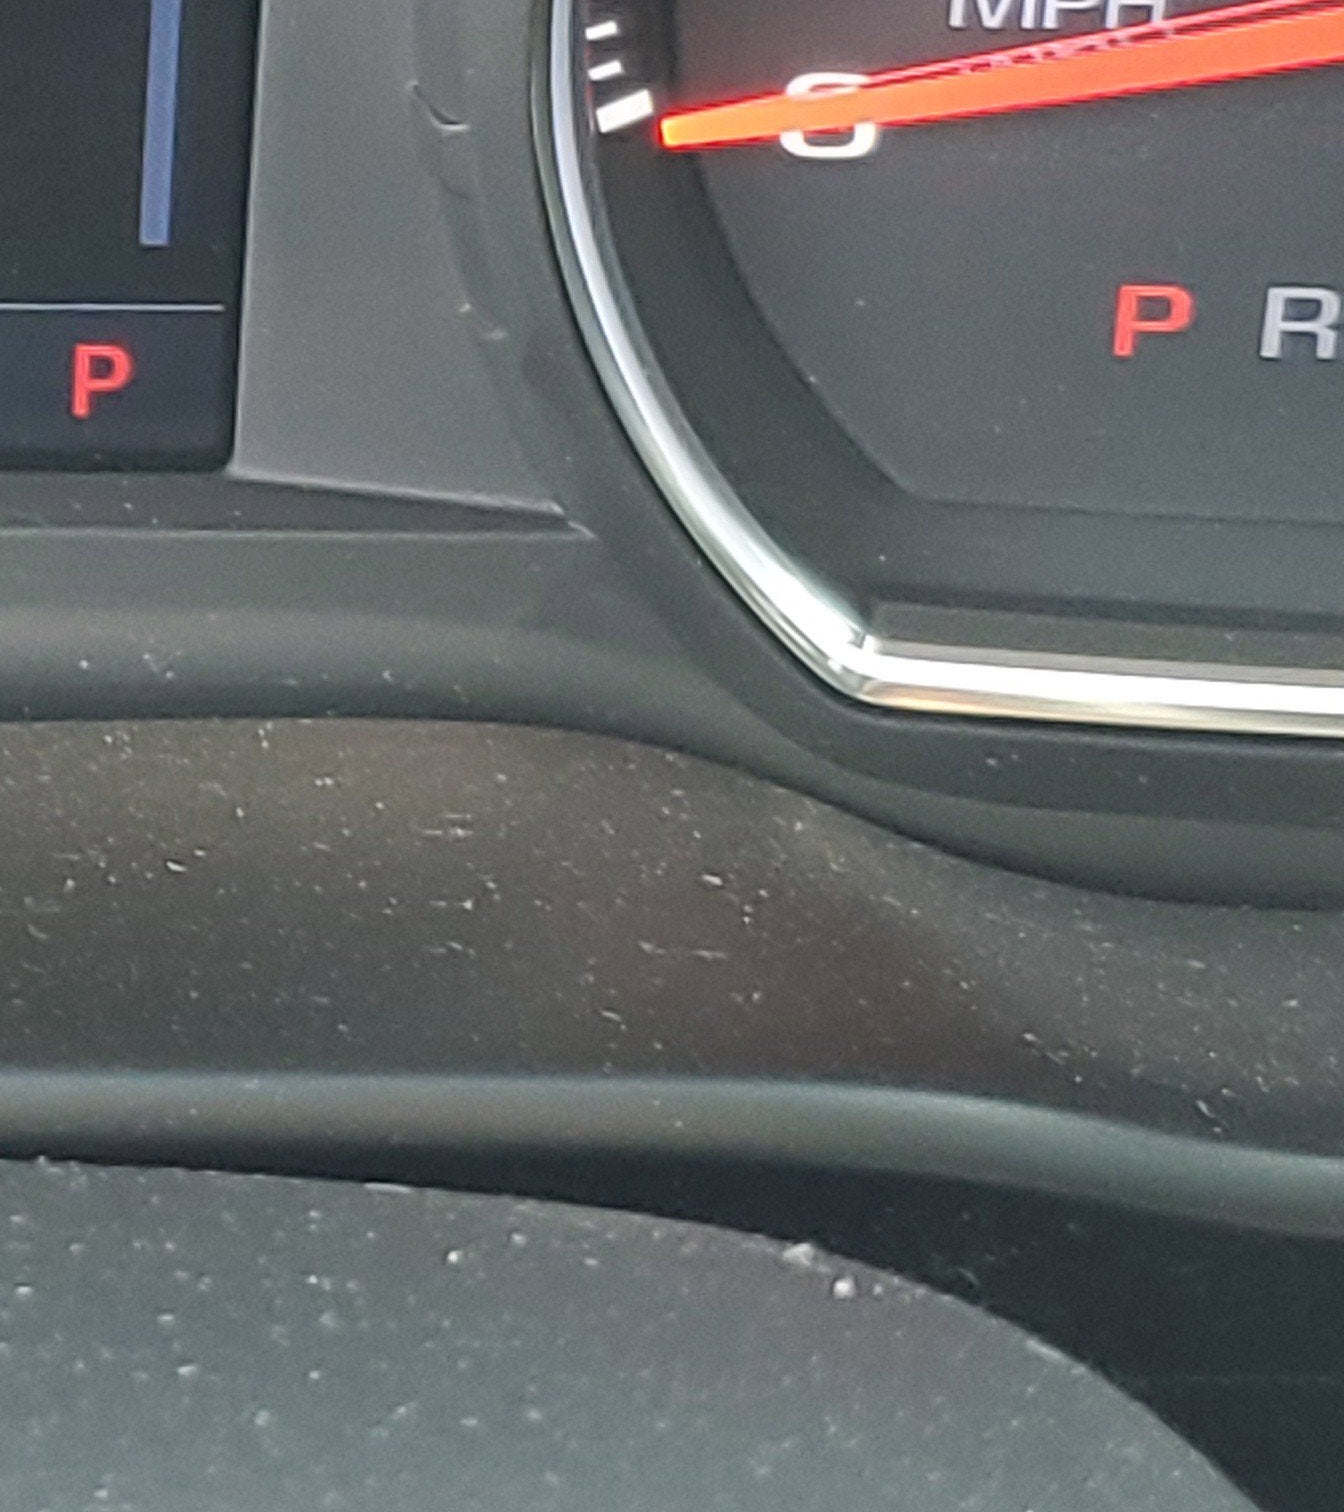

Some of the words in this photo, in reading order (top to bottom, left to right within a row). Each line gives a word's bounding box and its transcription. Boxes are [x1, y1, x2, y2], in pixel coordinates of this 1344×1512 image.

[1112, 284, 1195, 358] P
[1259, 287, 1342, 360] R
[70, 342, 136, 418] P
